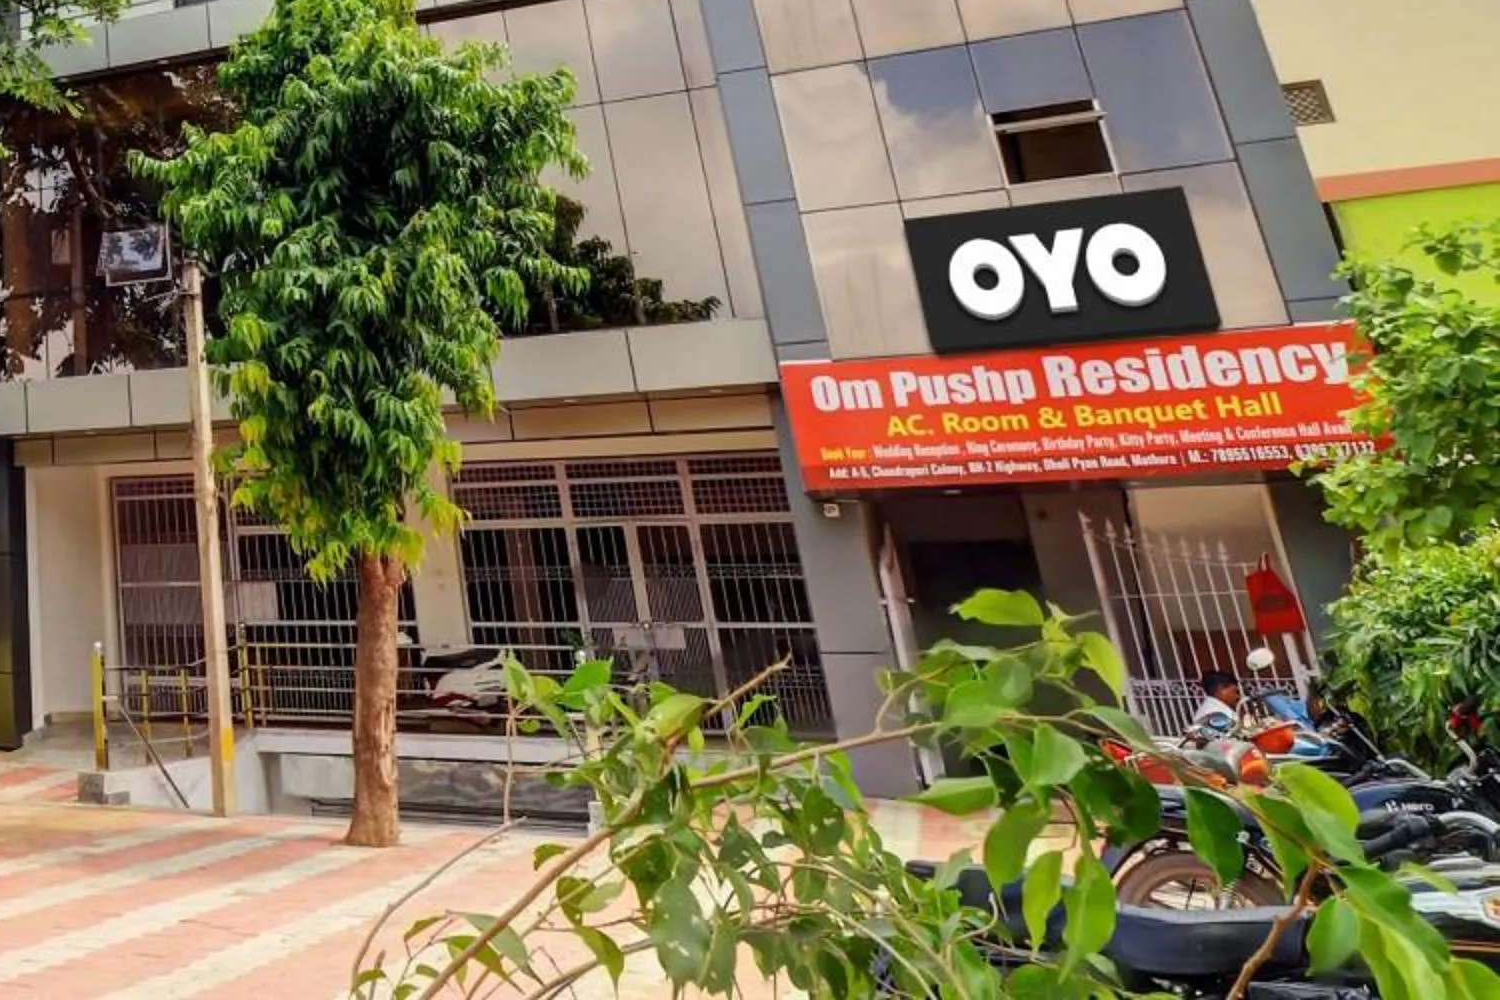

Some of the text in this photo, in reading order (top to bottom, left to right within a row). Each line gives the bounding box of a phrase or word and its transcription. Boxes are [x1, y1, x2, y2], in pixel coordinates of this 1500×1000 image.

[948, 222, 1167, 321] OYO
[811, 341, 1350, 411] Om Pushp Residency
[871, 443, 914, 461] Wedding
[1041, 435, 1085, 453] Birthday
[1180, 429, 1224, 445] Meeting
[1223, 426, 1235, 441] &
[1235, 424, 1297, 441] Conference
[1297, 421, 1321, 437] Hall
[887, 391, 1283, 437] AC. Room & Banquet Hall
